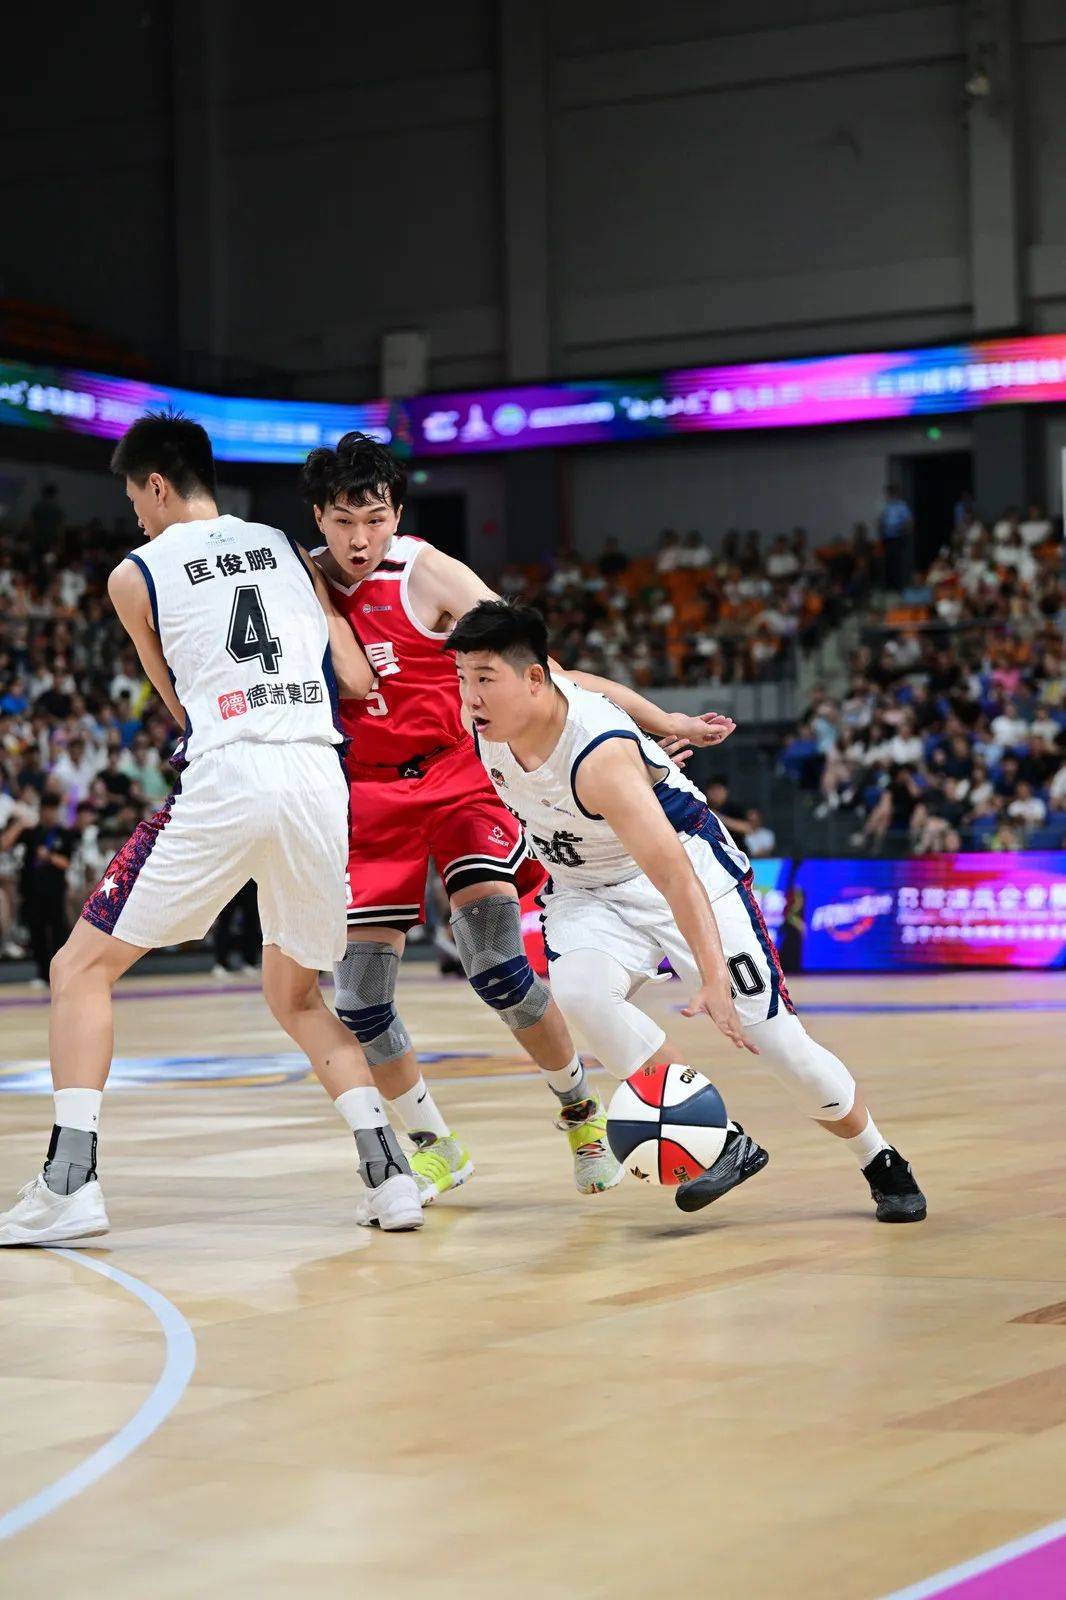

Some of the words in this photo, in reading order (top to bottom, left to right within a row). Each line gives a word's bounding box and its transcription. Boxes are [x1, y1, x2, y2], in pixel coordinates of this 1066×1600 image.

[184, 547, 278, 586] 匡俊鹏
[226, 584, 282, 675] 4
[246, 681, 323, 709] 德瑞集团
